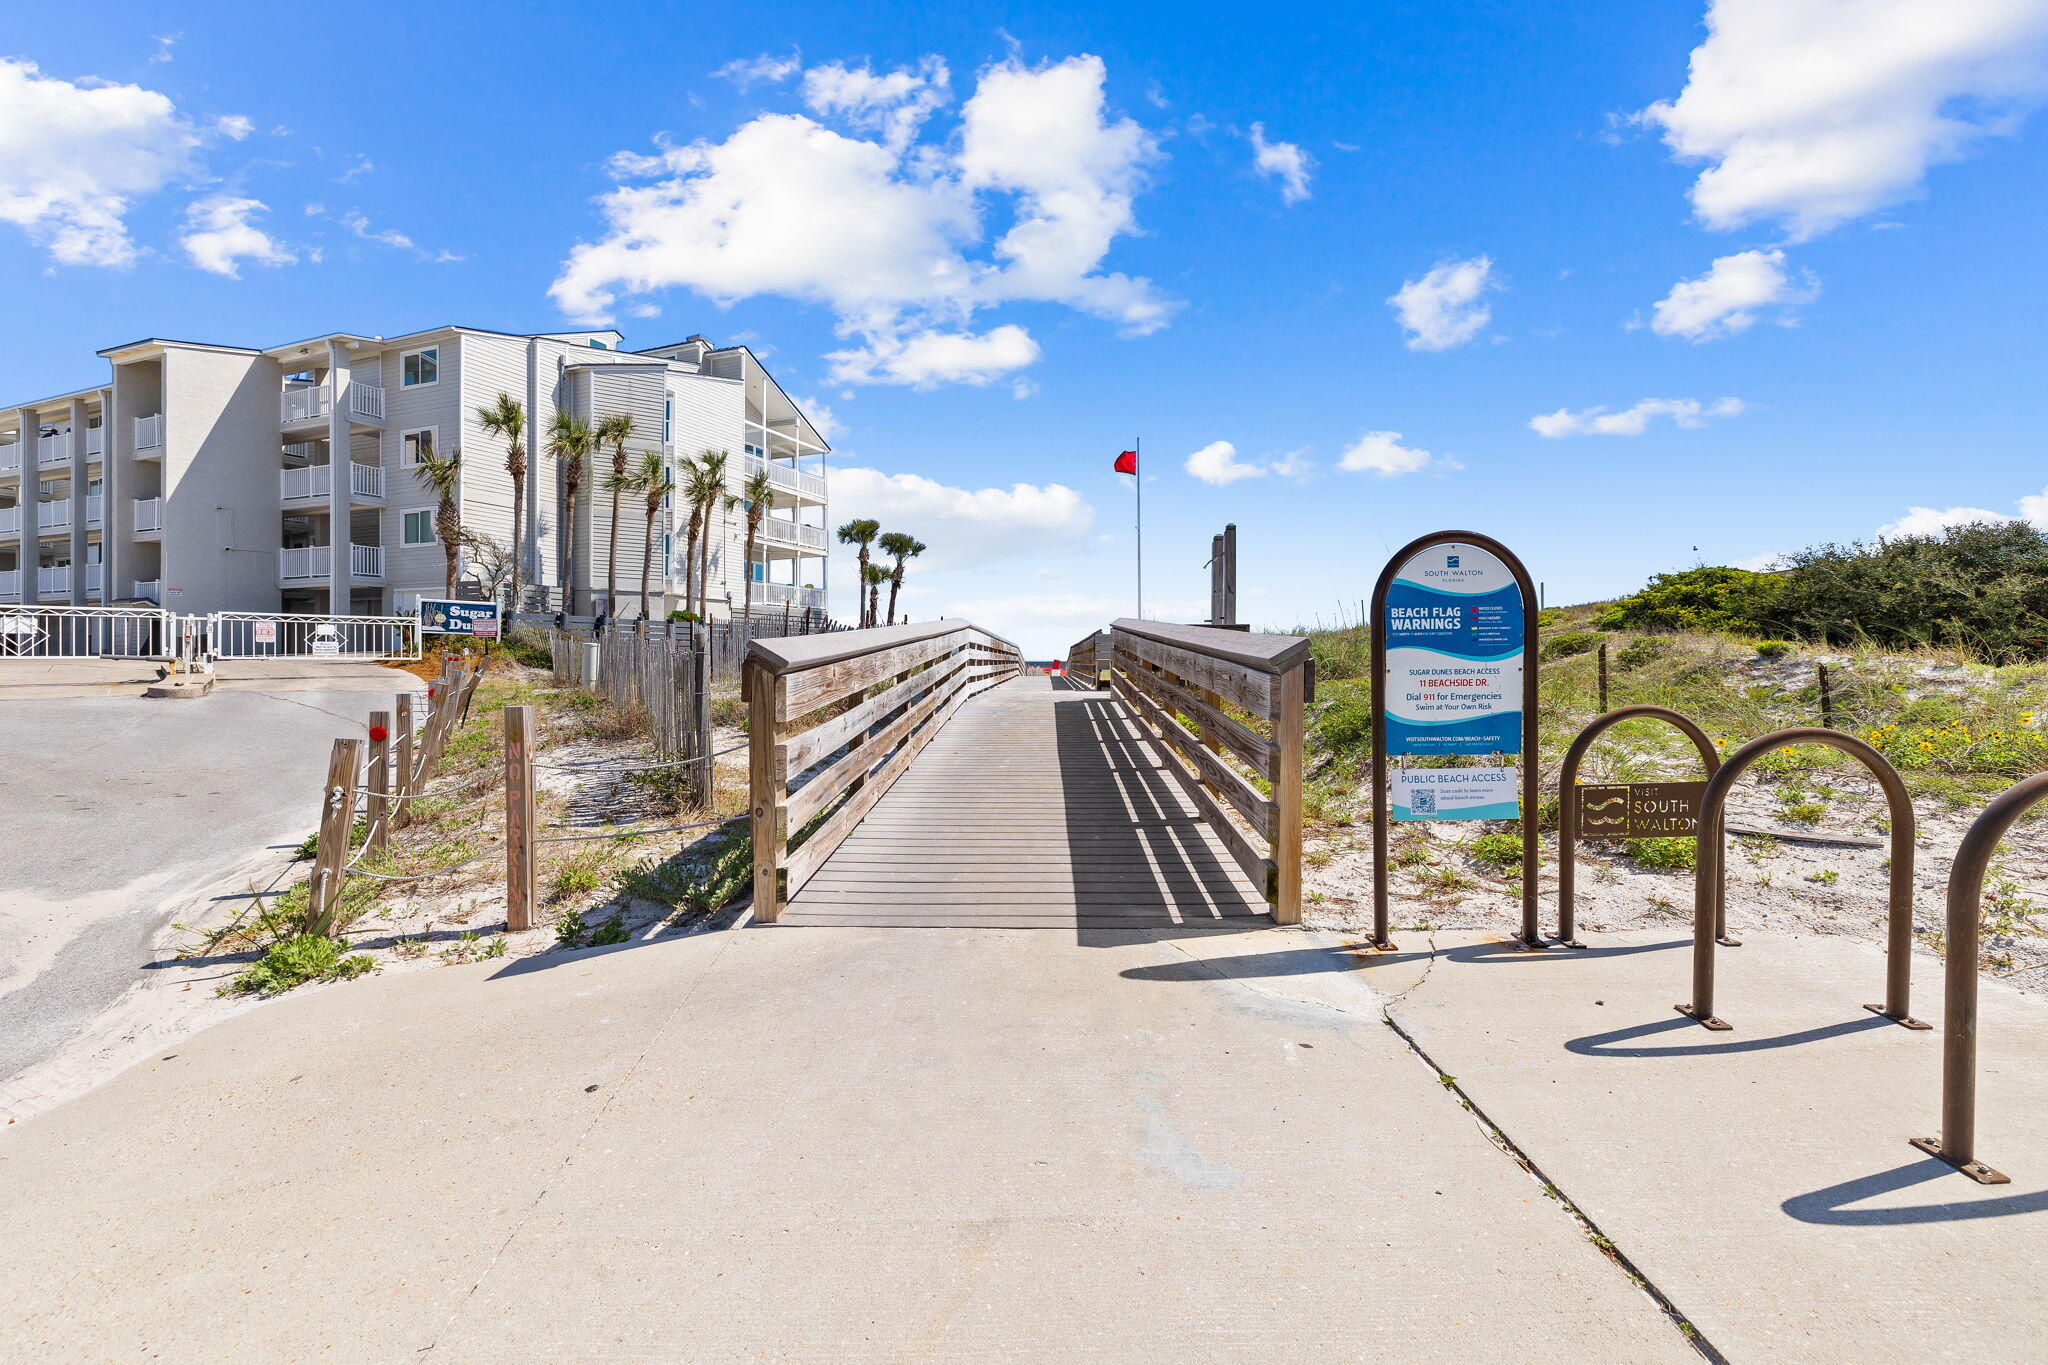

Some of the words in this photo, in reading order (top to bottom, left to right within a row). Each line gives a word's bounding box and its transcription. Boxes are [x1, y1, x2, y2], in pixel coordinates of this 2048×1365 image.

[1452, 569, 1483, 577] WALTON
[449, 605, 493, 619] Sugar
[1391, 607, 1429, 618] BEACH
[1432, 606, 1461, 617] FLAG
[1391, 618, 1461, 630] WARNINGS
[1431, 668, 1453, 676] DUNES
[1476, 667, 1500, 675] ACCESS
[1428, 679, 1474, 687] BEACHSIDE
[1475, 678, 1489, 687] DR.
[1406, 693, 1421, 701] Dial
[1437, 692, 1448, 701] for
[1450, 692, 1502, 702] Emergencies
[1415, 703, 1435, 711] Swim
[509, 742, 521, 781] NO
[1401, 775, 1436, 784] PUBLIC
[1437, 774, 1469, 783] BEACH
[1471, 773, 1507, 782] ACCESS
[1634, 787, 1659, 797] VISIT
[1634, 799, 1689, 814] SOUTH
